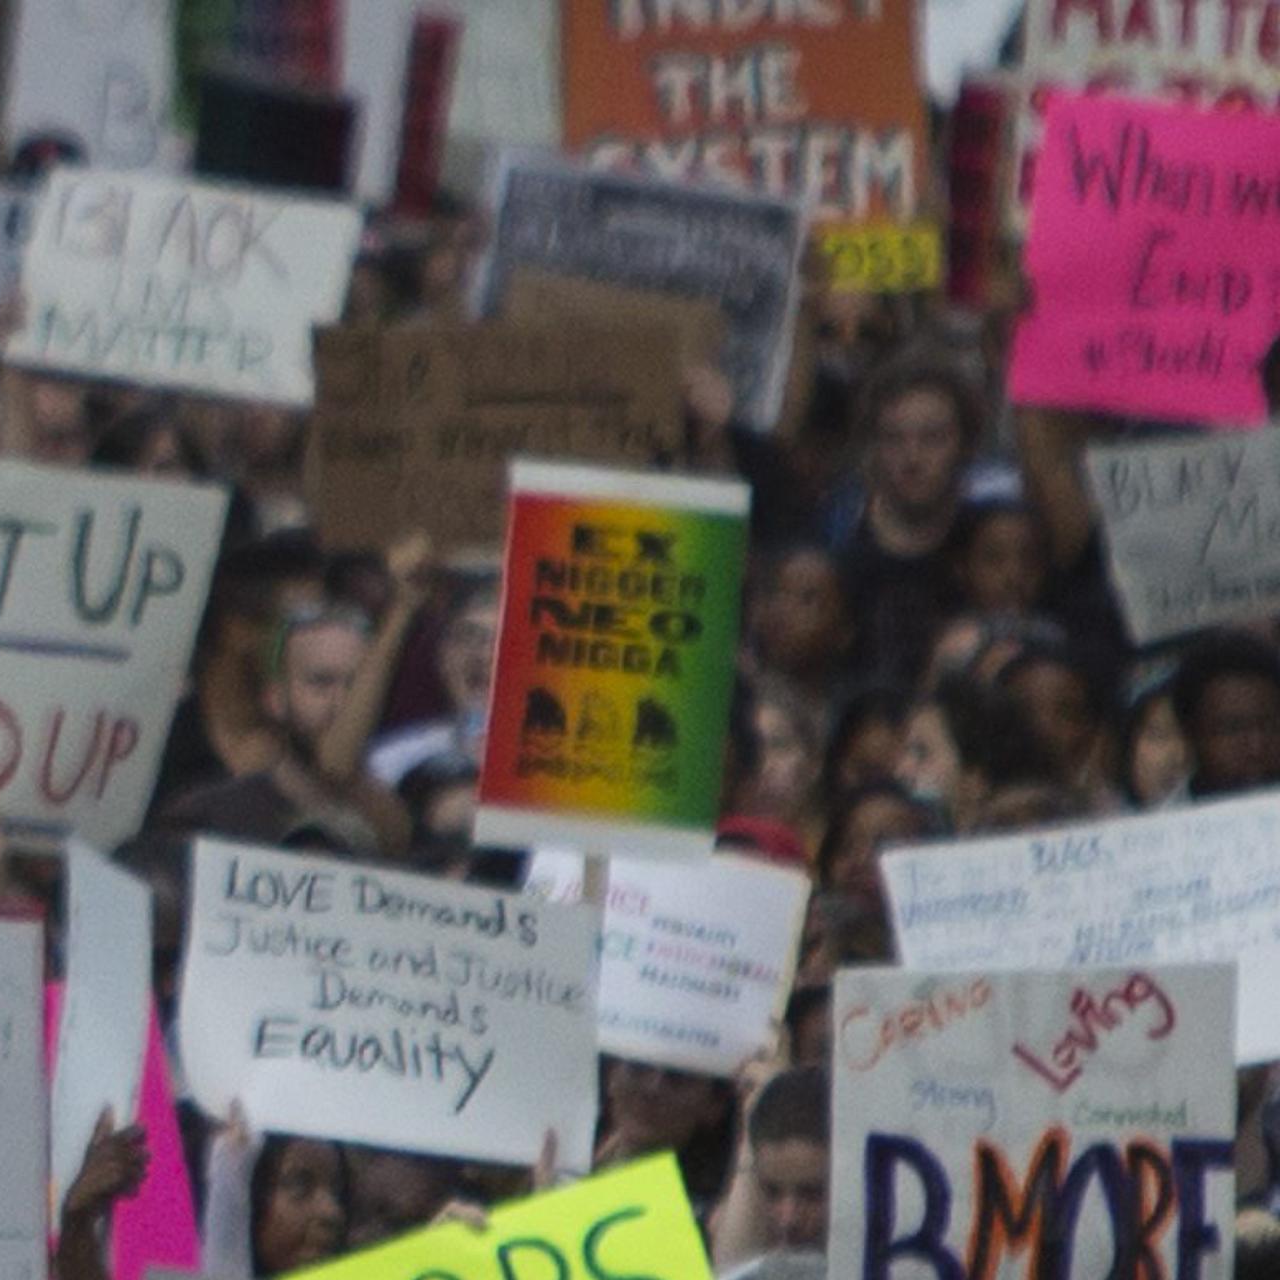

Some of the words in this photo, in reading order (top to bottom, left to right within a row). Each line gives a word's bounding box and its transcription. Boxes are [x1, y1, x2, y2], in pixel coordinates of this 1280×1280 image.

[650, 46, 808, 126] THE
[71, 505, 186, 626] UP
[40, 709, 140, 802] UP
[224, 857, 333, 915] LOVE
[367, 937, 438, 980] and
